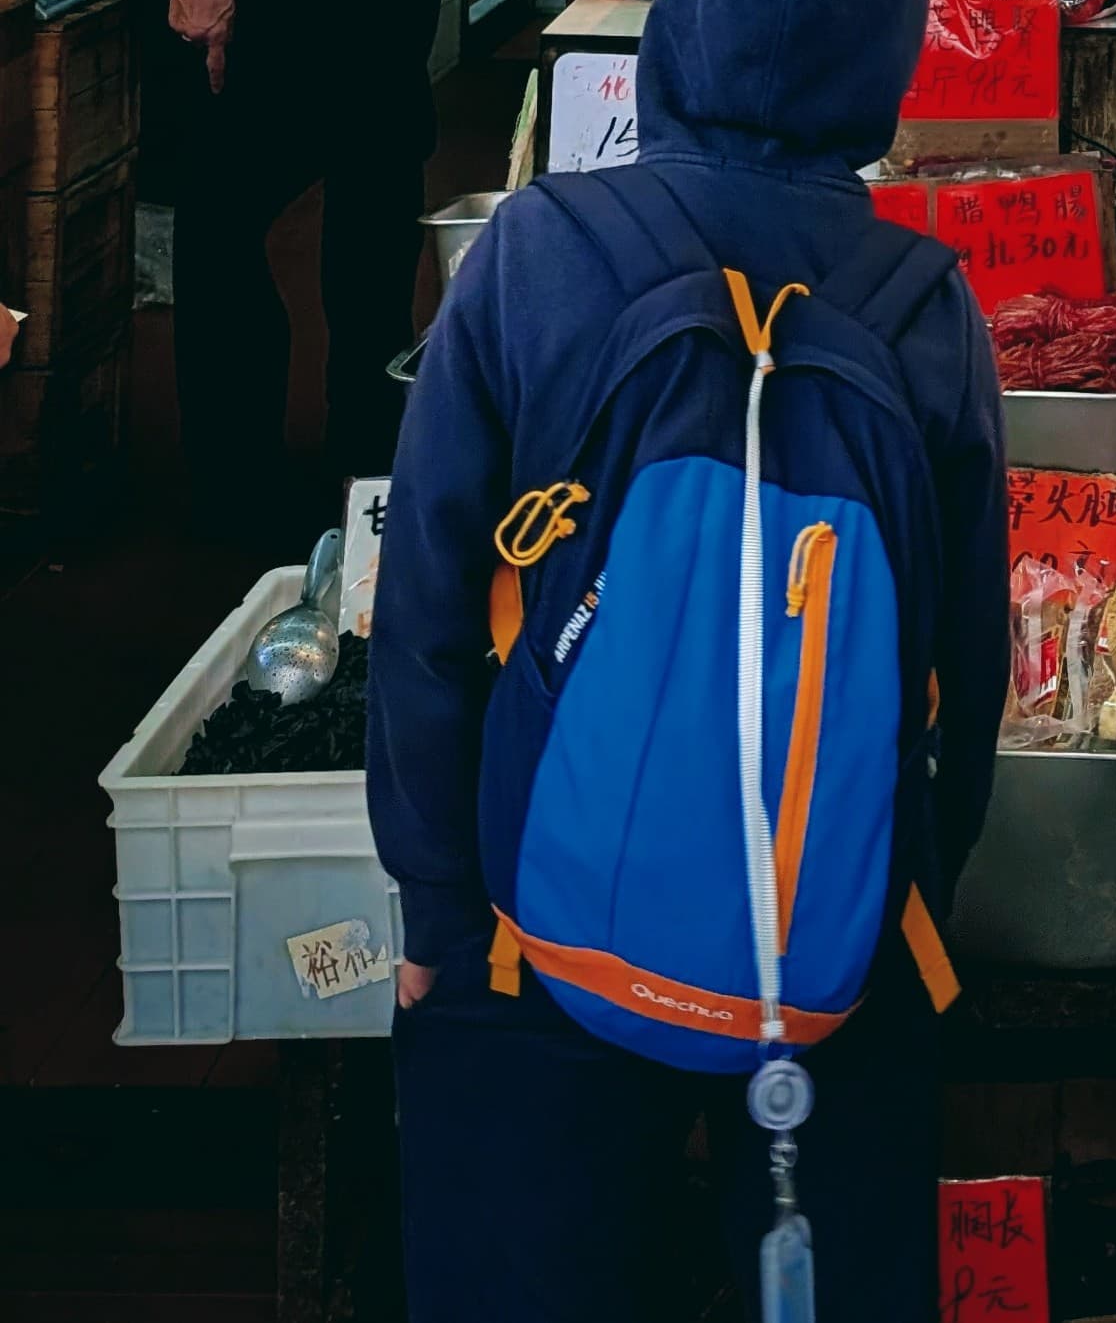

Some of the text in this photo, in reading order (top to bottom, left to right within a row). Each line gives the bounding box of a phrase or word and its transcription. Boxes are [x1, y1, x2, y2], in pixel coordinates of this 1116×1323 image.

[908, 60, 1040, 107] 斤98元
[554, 604, 593, 664] ARPENAZ
[630, 983, 734, 1021] Quechua
